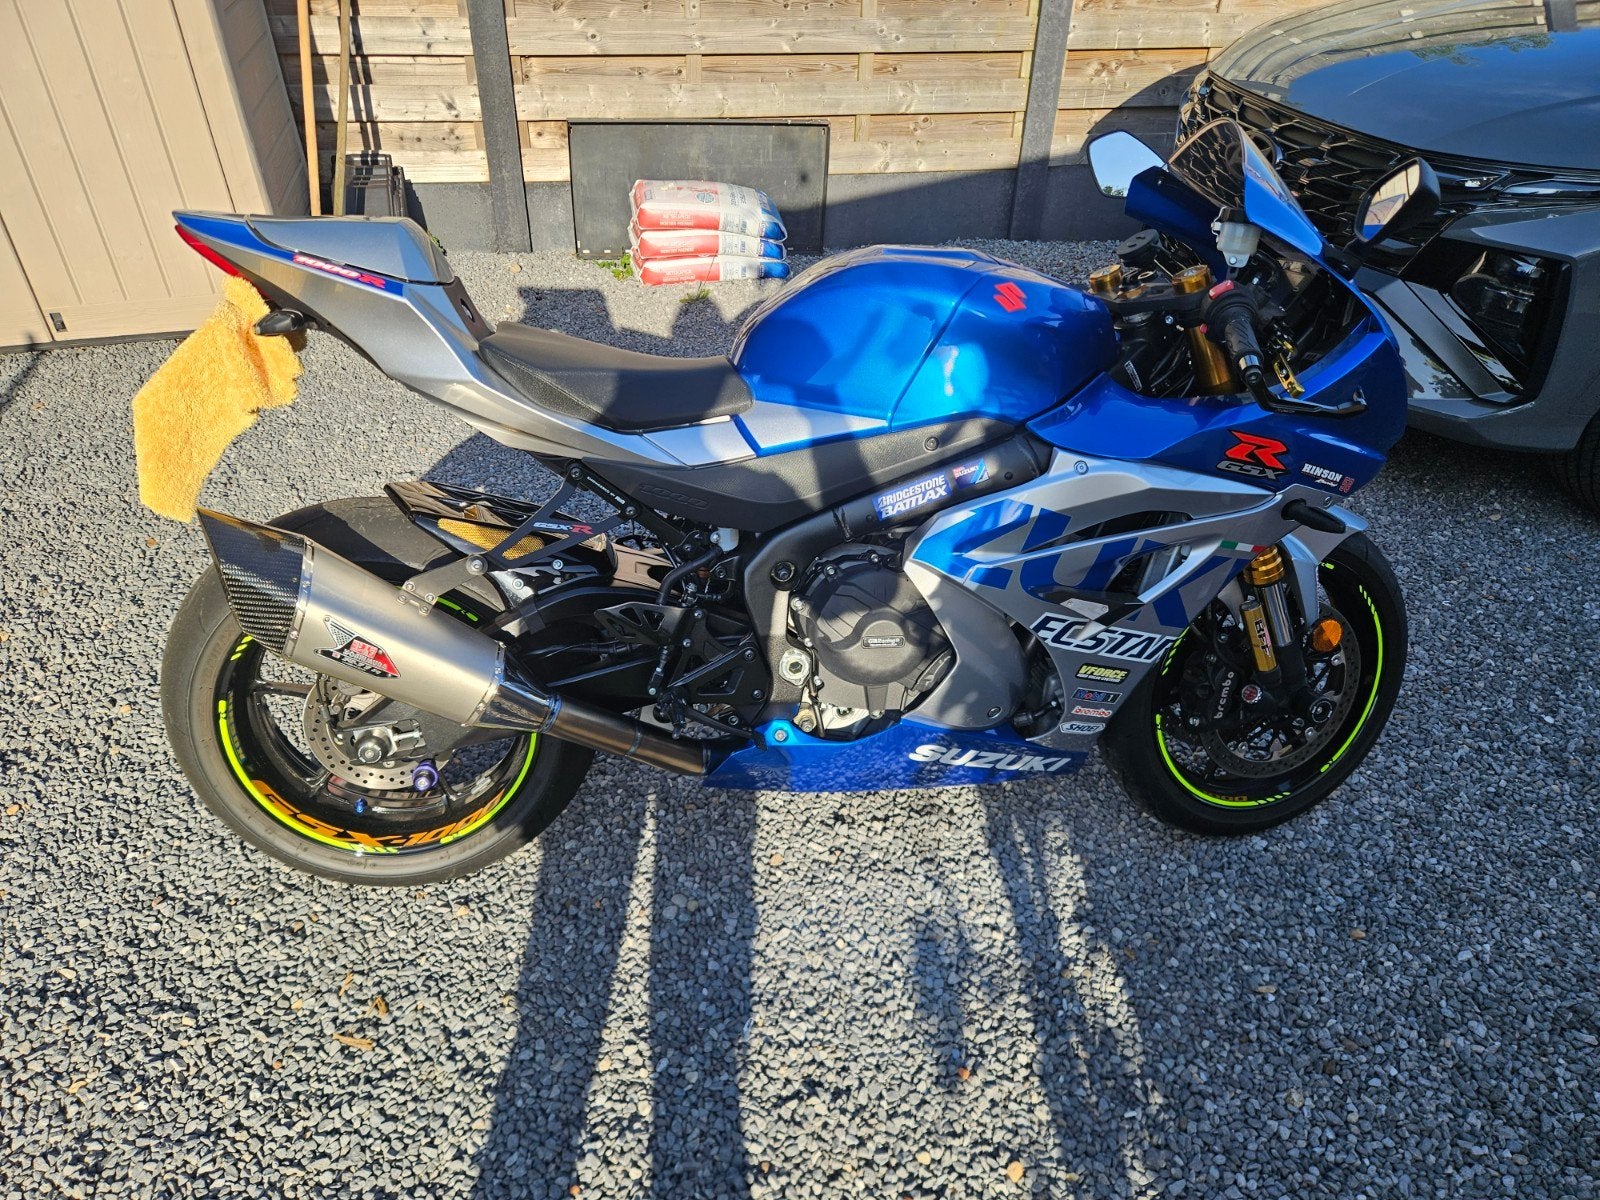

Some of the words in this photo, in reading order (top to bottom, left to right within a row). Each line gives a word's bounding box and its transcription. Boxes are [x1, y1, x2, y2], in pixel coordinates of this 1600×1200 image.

[1216, 460, 1284, 480] GSX
[1301, 463, 1343, 483] HINSON
[878, 474, 946, 508] BRIDGESTONE
[881, 484, 948, 519] BATTLAX
[1078, 665, 1128, 678] VFORCE
[1213, 671, 1235, 719] brembo
[1073, 706, 1111, 717] brembo
[1066, 723, 1100, 732] SHOEI
[908, 744, 1071, 772] SUZUKI
